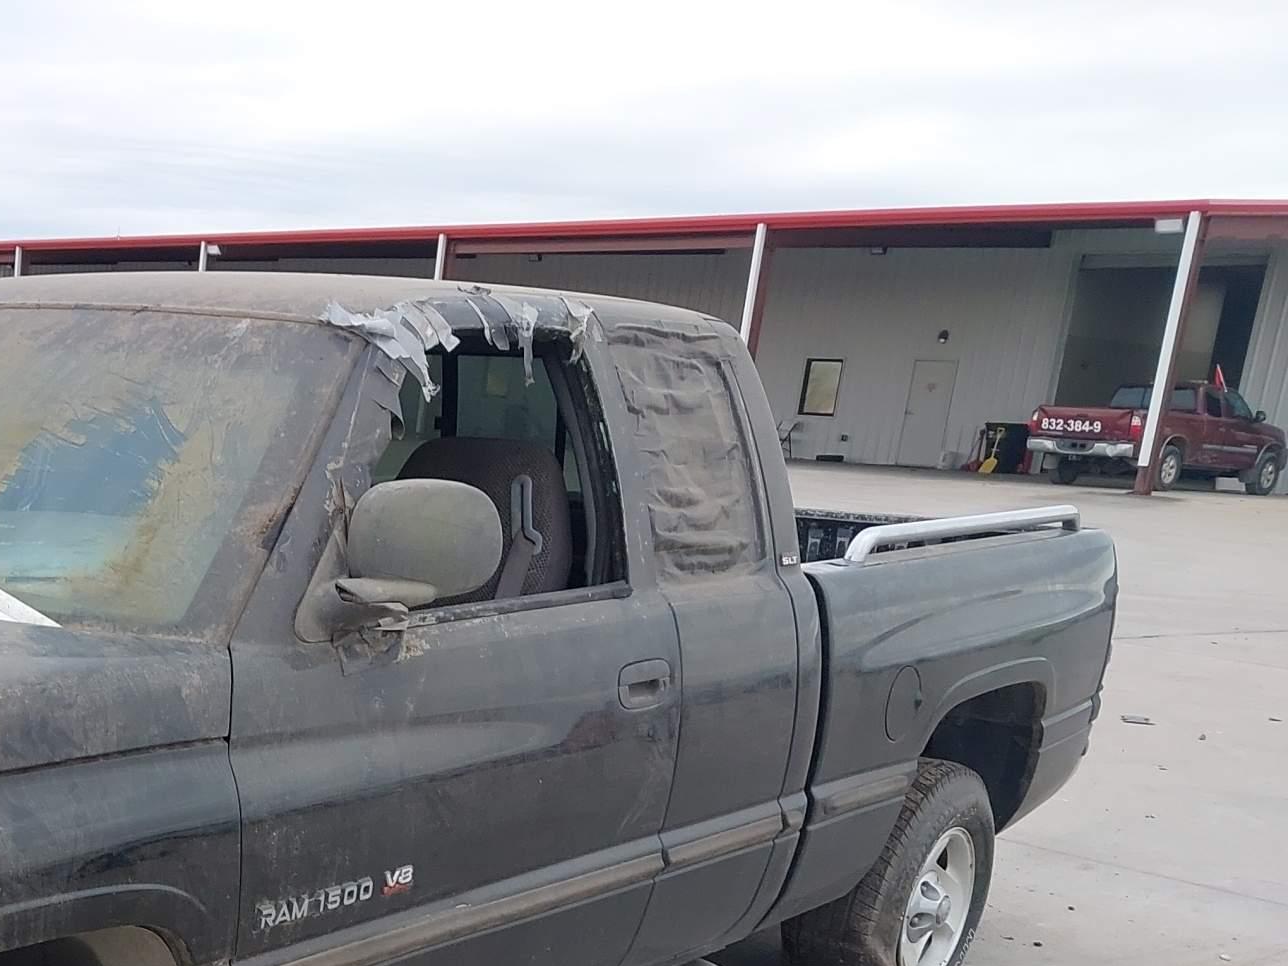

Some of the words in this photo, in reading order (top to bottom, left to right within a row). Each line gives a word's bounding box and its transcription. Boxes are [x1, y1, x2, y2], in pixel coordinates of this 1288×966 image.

[1041, 418, 1102, 433] 832-384-9
[782, 555, 798, 566] SLT
[256, 894, 309, 928] RAM
[316, 876, 374, 912] 1500
[384, 865, 414, 887] V8
